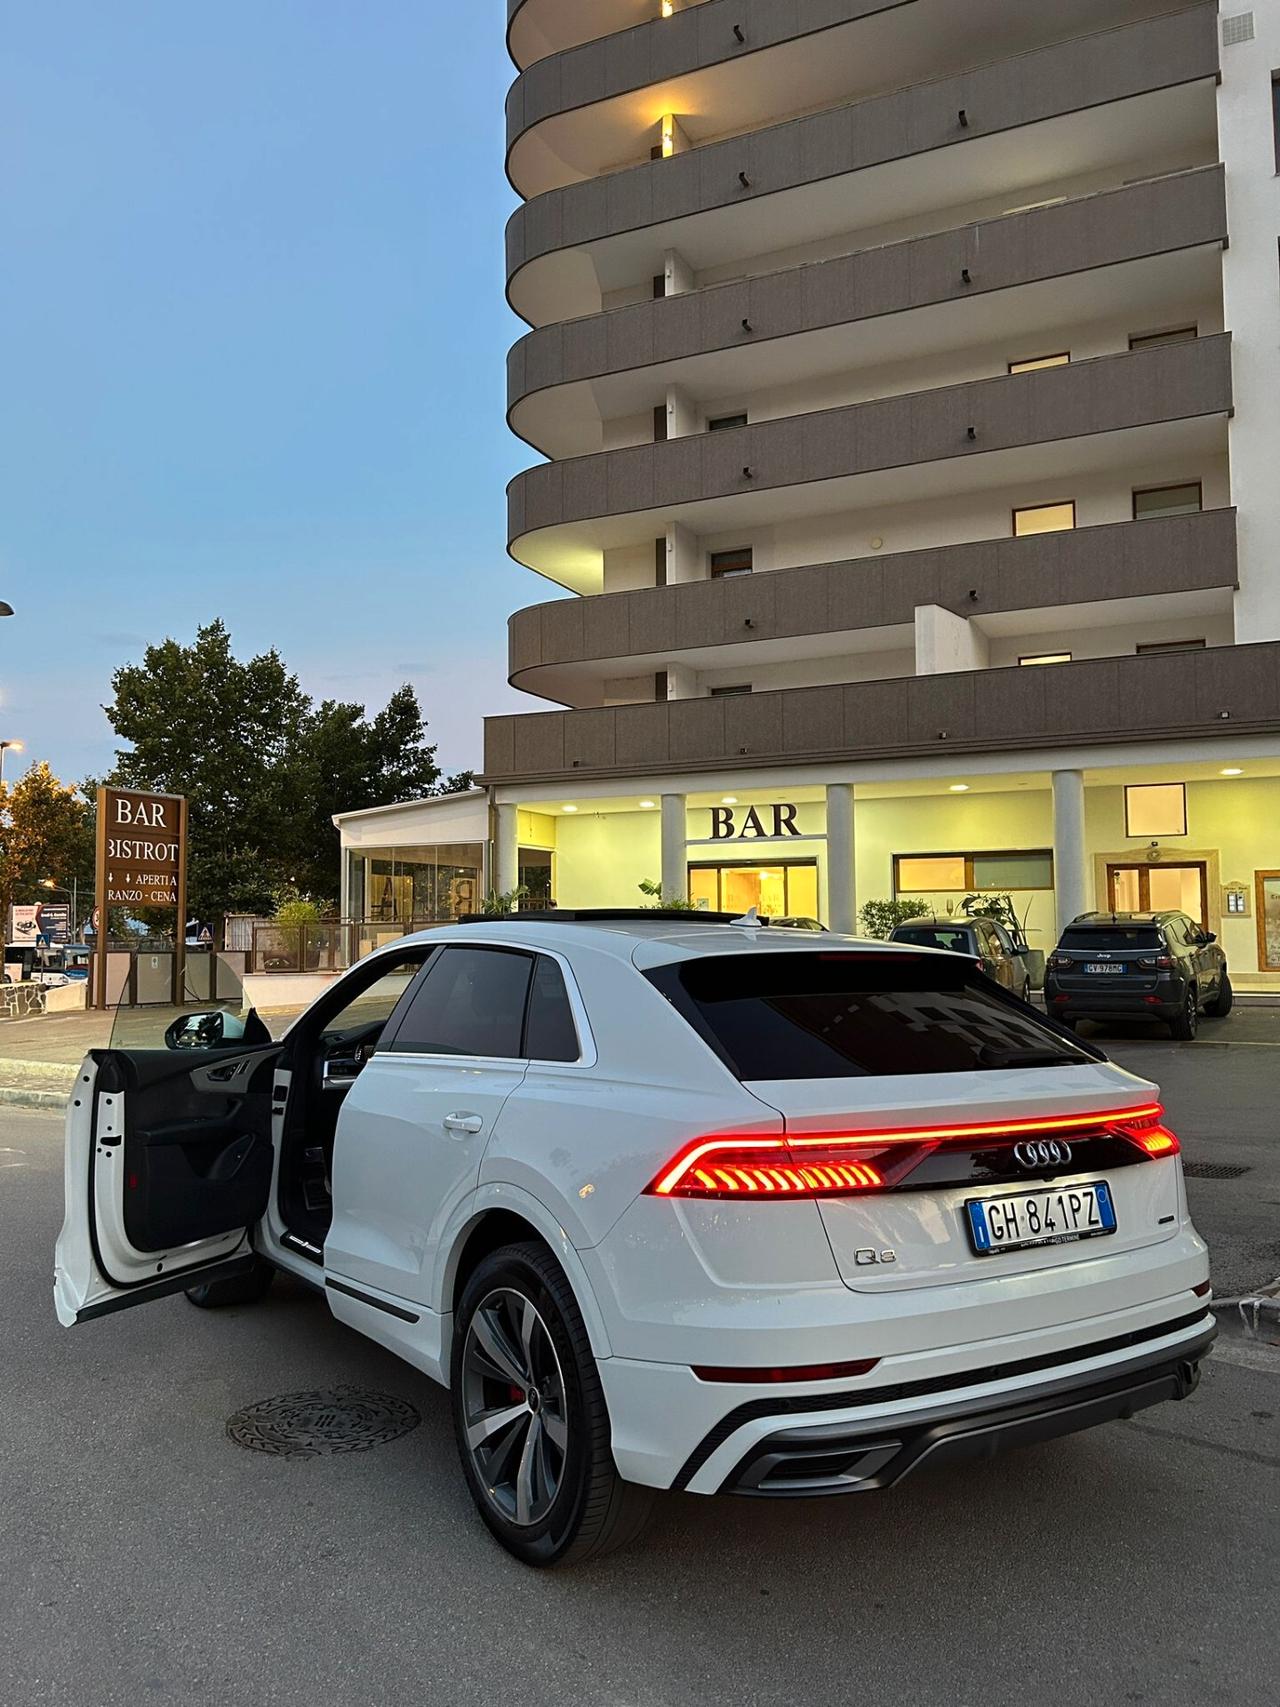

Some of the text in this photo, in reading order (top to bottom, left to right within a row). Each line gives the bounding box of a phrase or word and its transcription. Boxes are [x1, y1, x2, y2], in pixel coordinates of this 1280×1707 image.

[115, 798, 167, 828] BAR
[709, 803, 802, 839] BAR
[136, 874, 168, 885] APERTI
[150, 890, 177, 902] CENA
[1026, 1191, 1099, 1234] 841PZ
[854, 1247, 897, 1265] Q8
